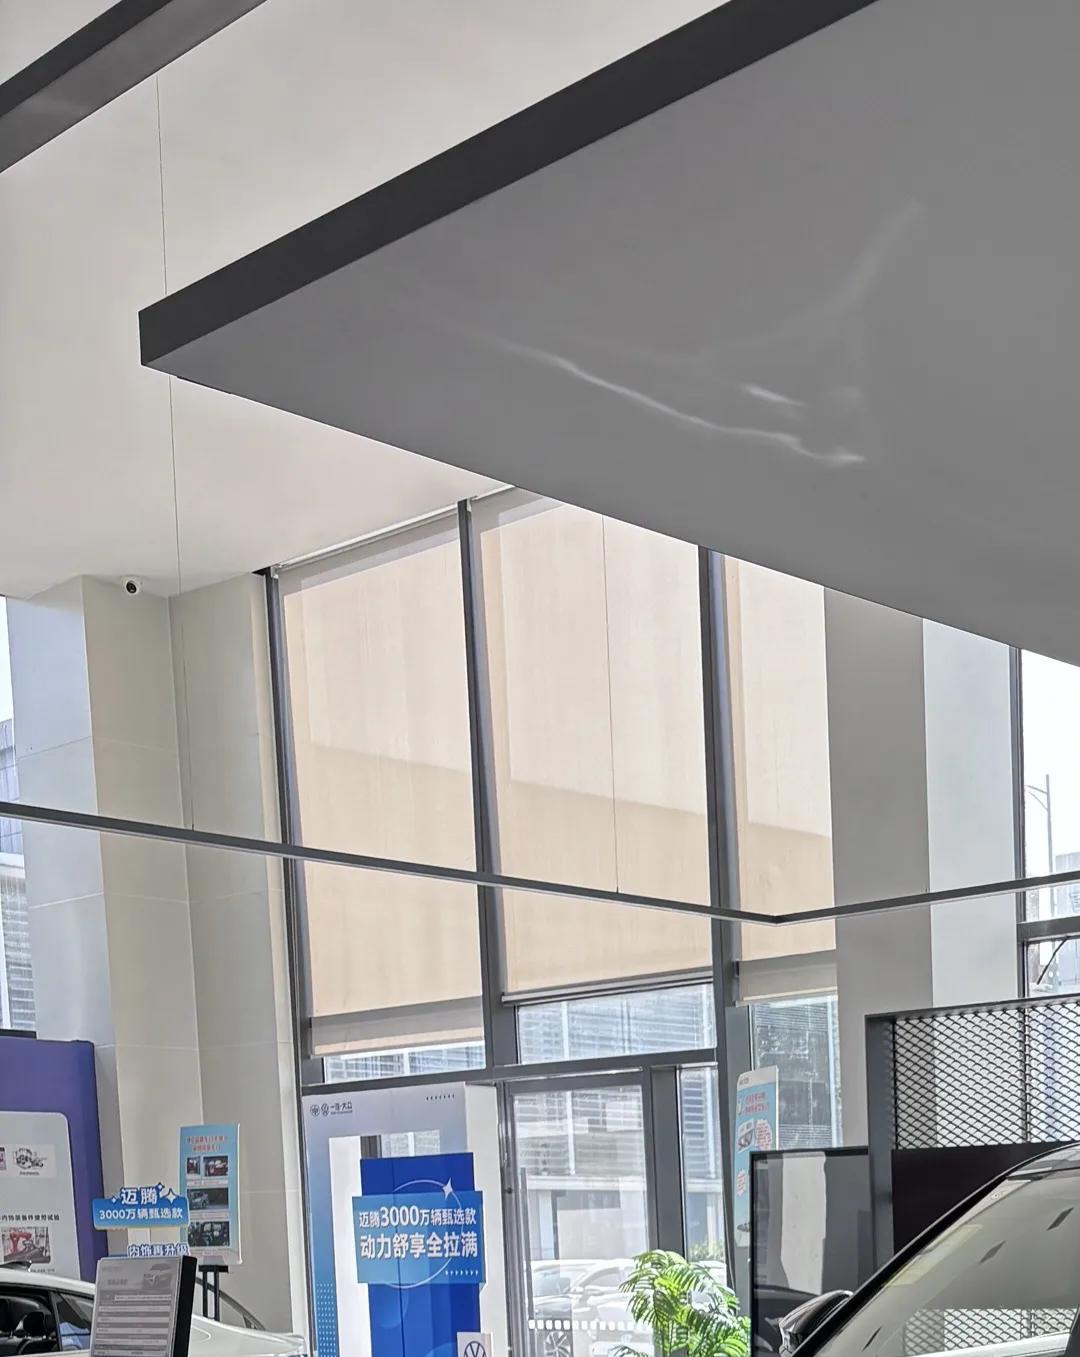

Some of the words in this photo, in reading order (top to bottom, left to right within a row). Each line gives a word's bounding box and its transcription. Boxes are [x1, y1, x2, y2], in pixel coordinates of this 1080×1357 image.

[121, 1188, 158, 1205] 迈腾
[100, 1207, 183, 1220] 3000万辆甄选款
[359, 1205, 477, 1228] 迈腾3000万辆甄选款
[360, 1231, 478, 1259] 动力舒享全拉满
